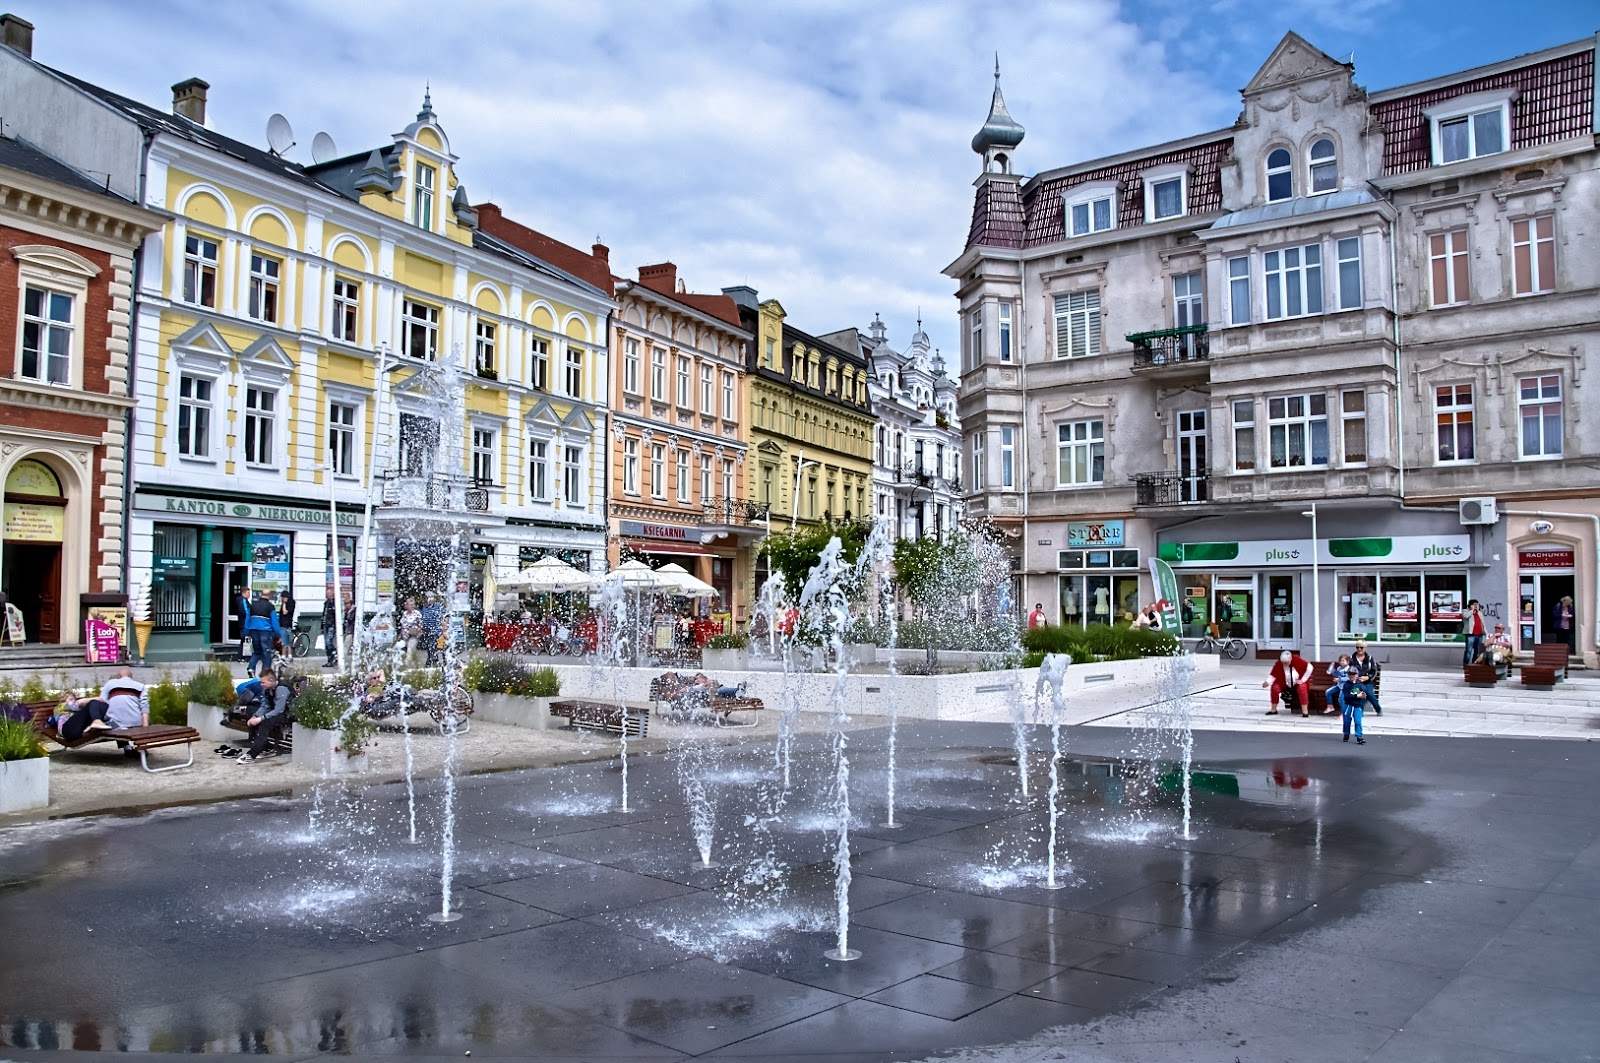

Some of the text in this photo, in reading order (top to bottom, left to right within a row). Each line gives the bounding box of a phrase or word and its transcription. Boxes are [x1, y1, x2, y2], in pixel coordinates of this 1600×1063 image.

[166, 498, 226, 515] KANTOR
[1266, 549, 1290, 561] plus
[1424, 544, 1452, 558] plus
[97, 628, 116, 639] Lody
